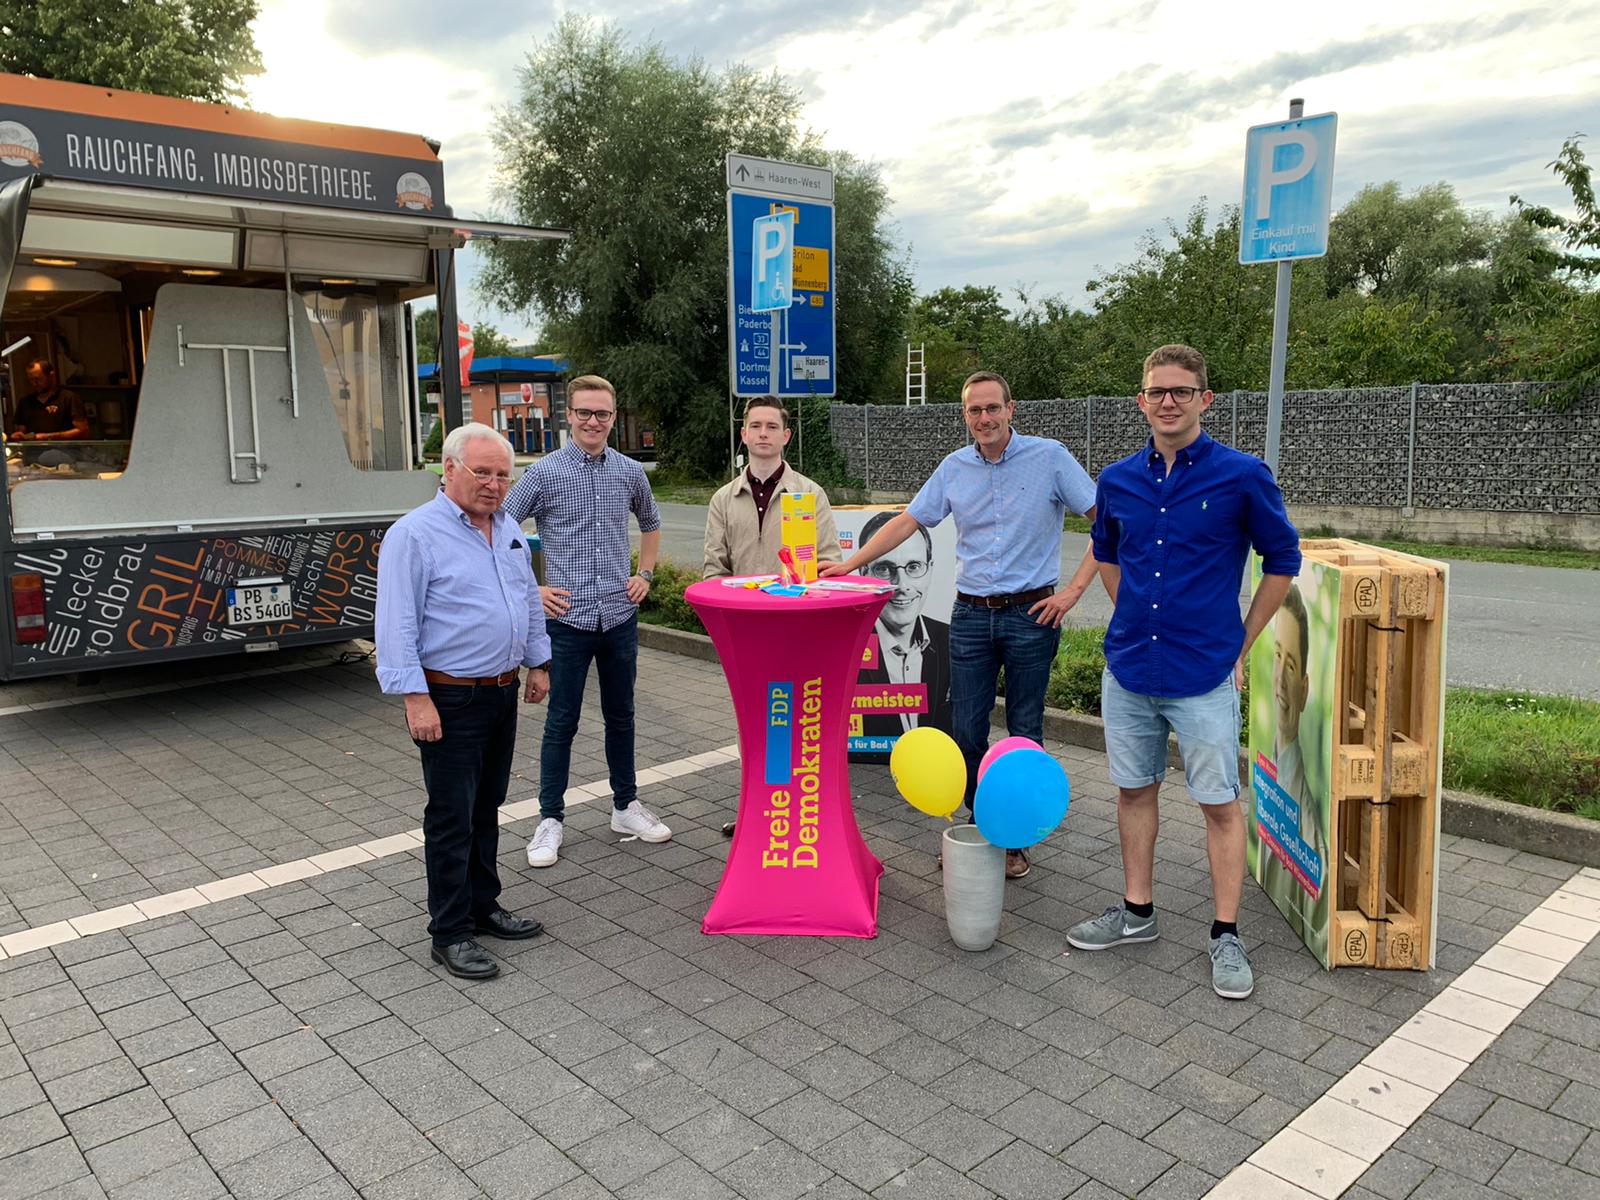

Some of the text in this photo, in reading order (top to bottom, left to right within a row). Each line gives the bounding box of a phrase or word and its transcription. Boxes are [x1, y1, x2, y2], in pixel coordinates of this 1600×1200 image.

[66, 133, 377, 201] RAUCHFANG. IMBISSBETRIEBE.
[768, 171, 821, 189] Haaren-West
[1256, 130, 1318, 220] P
[758, 223, 786, 282] P
[1268, 240, 1296, 254] Kind
[738, 318, 771, 330] Paderbo
[740, 361, 770, 372] Dortmu
[740, 375, 768, 386] Kassel
[212, 538, 288, 574] POMMES
[127, 540, 208, 651] GRIL
[243, 589, 263, 605] PB
[293, 559, 325, 611] frisch
[1359, 582, 1374, 607] EPAL
[233, 602, 291, 622] BS 5400
[339, 605, 375, 627] TO
[770, 687, 789, 727] FDP
[870, 739, 889, 749] Bad
[792, 676, 823, 869] Demokraten
[1253, 766, 1285, 813] Integration
[1285, 803, 1298, 826] und
[761, 789, 791, 869] Freie
[1279, 822, 1320, 879] Gesellschaft
[1349, 934, 1364, 957] EPAL
